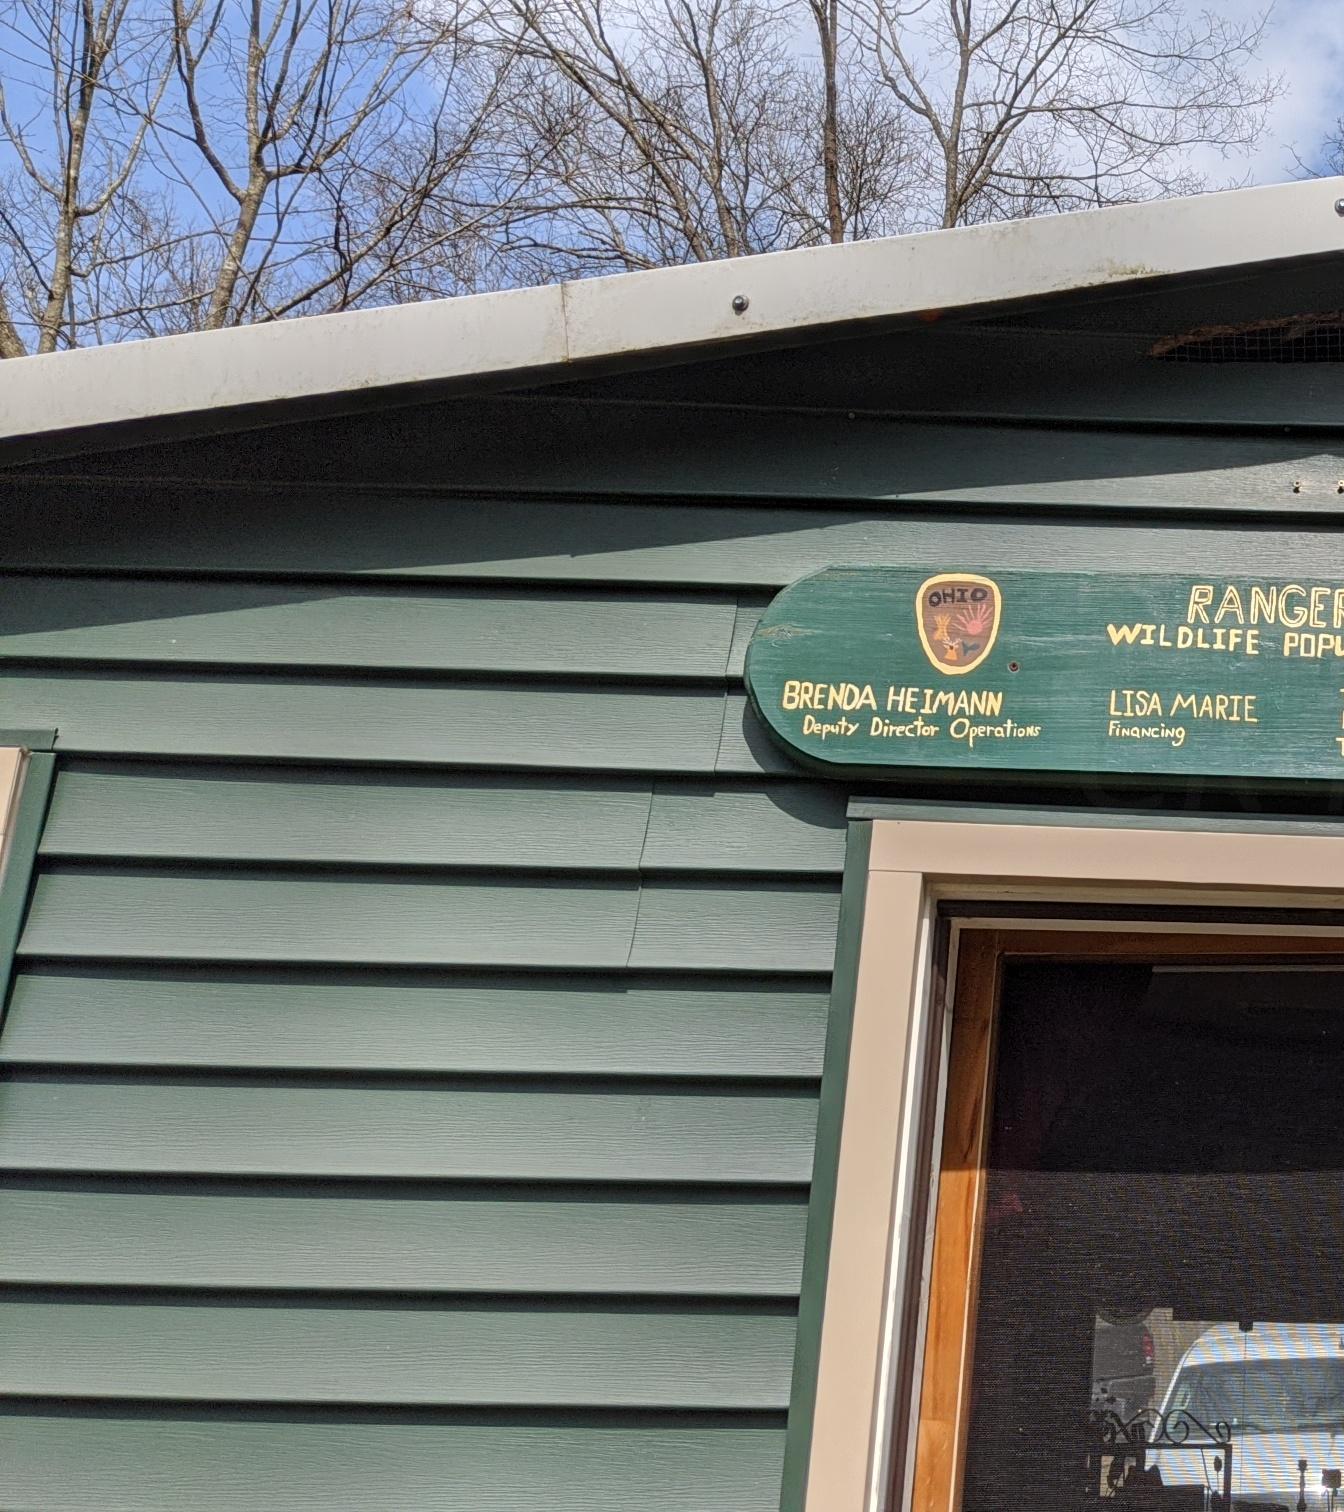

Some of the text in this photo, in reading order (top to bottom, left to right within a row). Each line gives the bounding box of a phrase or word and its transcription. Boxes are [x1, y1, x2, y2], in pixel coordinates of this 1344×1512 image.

[928, 588, 988, 607] OHIO
[1107, 623, 1259, 655] WILDLIFE
[782, 680, 1003, 716] BRENDA HEIMANN
[1109, 689, 1260, 722] LISA MARIE
[803, 715, 1042, 748] Deputy Director Operations
[1108, 720, 1186, 747] Financing
